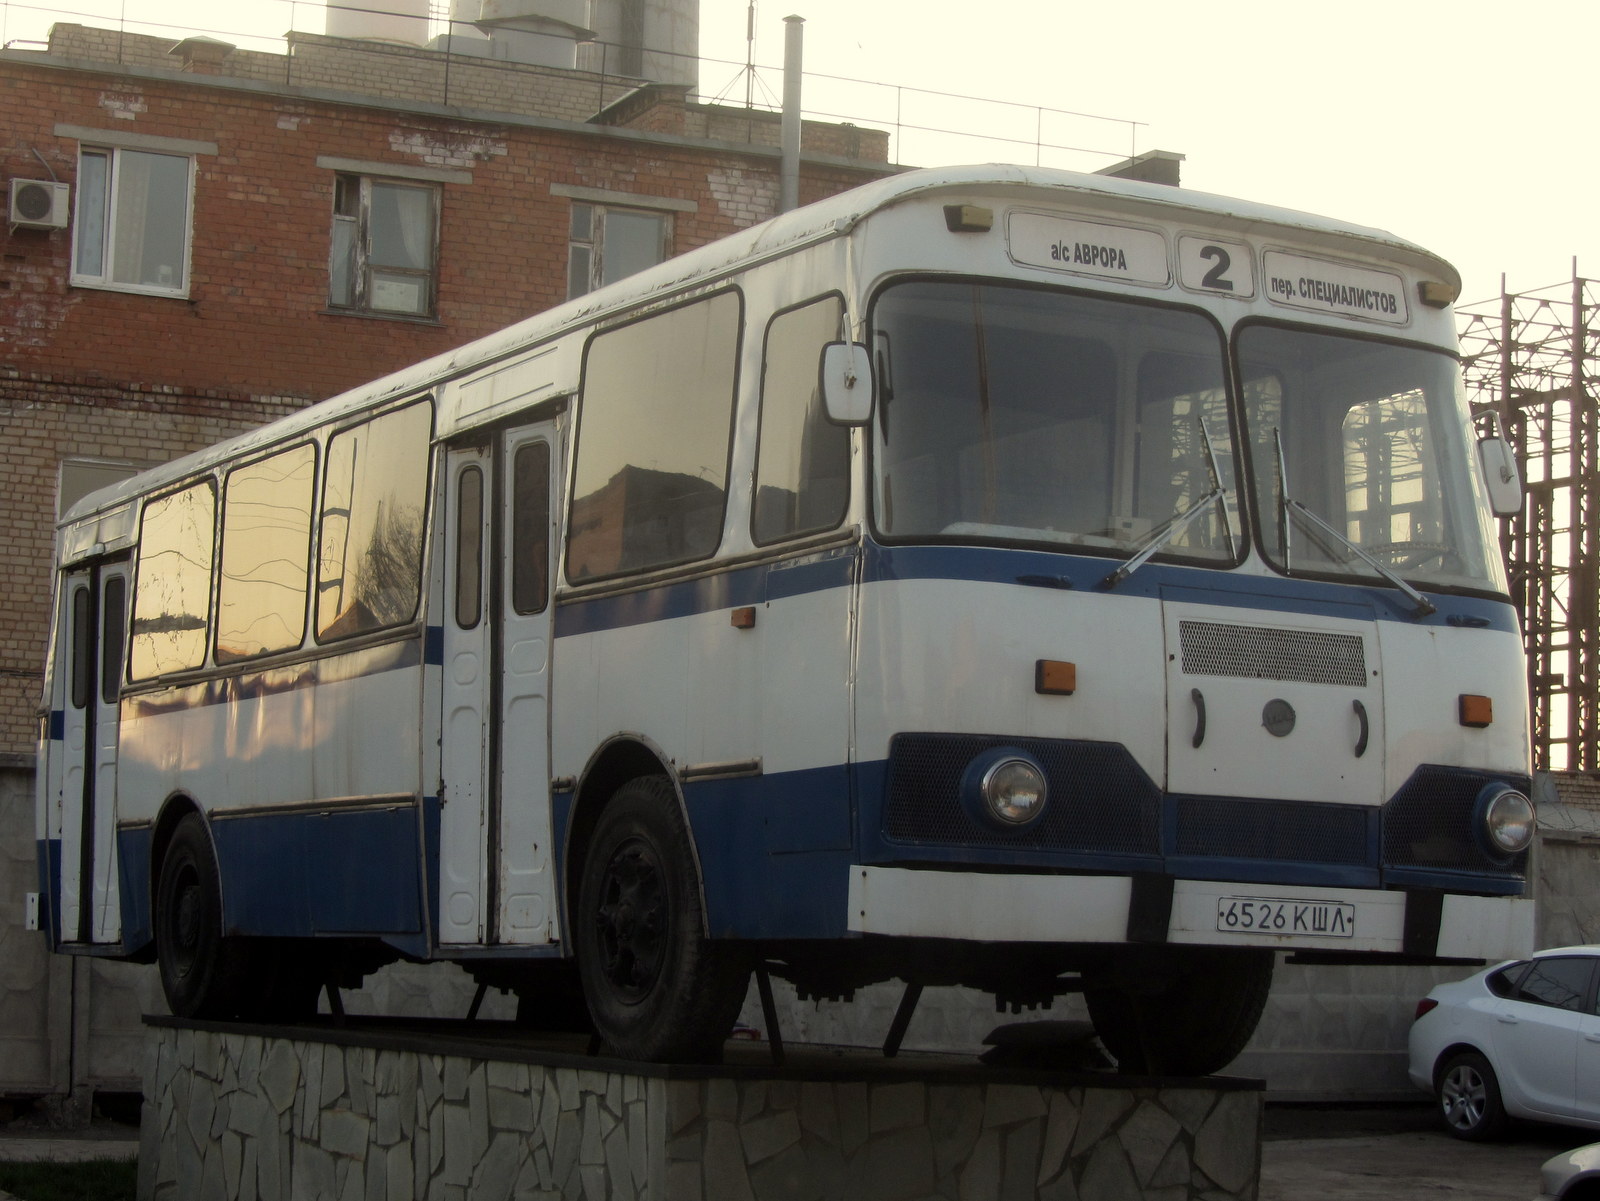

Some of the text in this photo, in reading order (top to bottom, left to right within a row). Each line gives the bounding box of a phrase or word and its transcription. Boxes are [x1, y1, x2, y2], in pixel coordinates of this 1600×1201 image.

[1074, 242, 1127, 270] АВРОРА
[1199, 245, 1234, 291] 2
[1271, 277, 1397, 314] пер. СПЕЦИАЛИСТОВ
[1225, 902, 1285, 929] 6526
